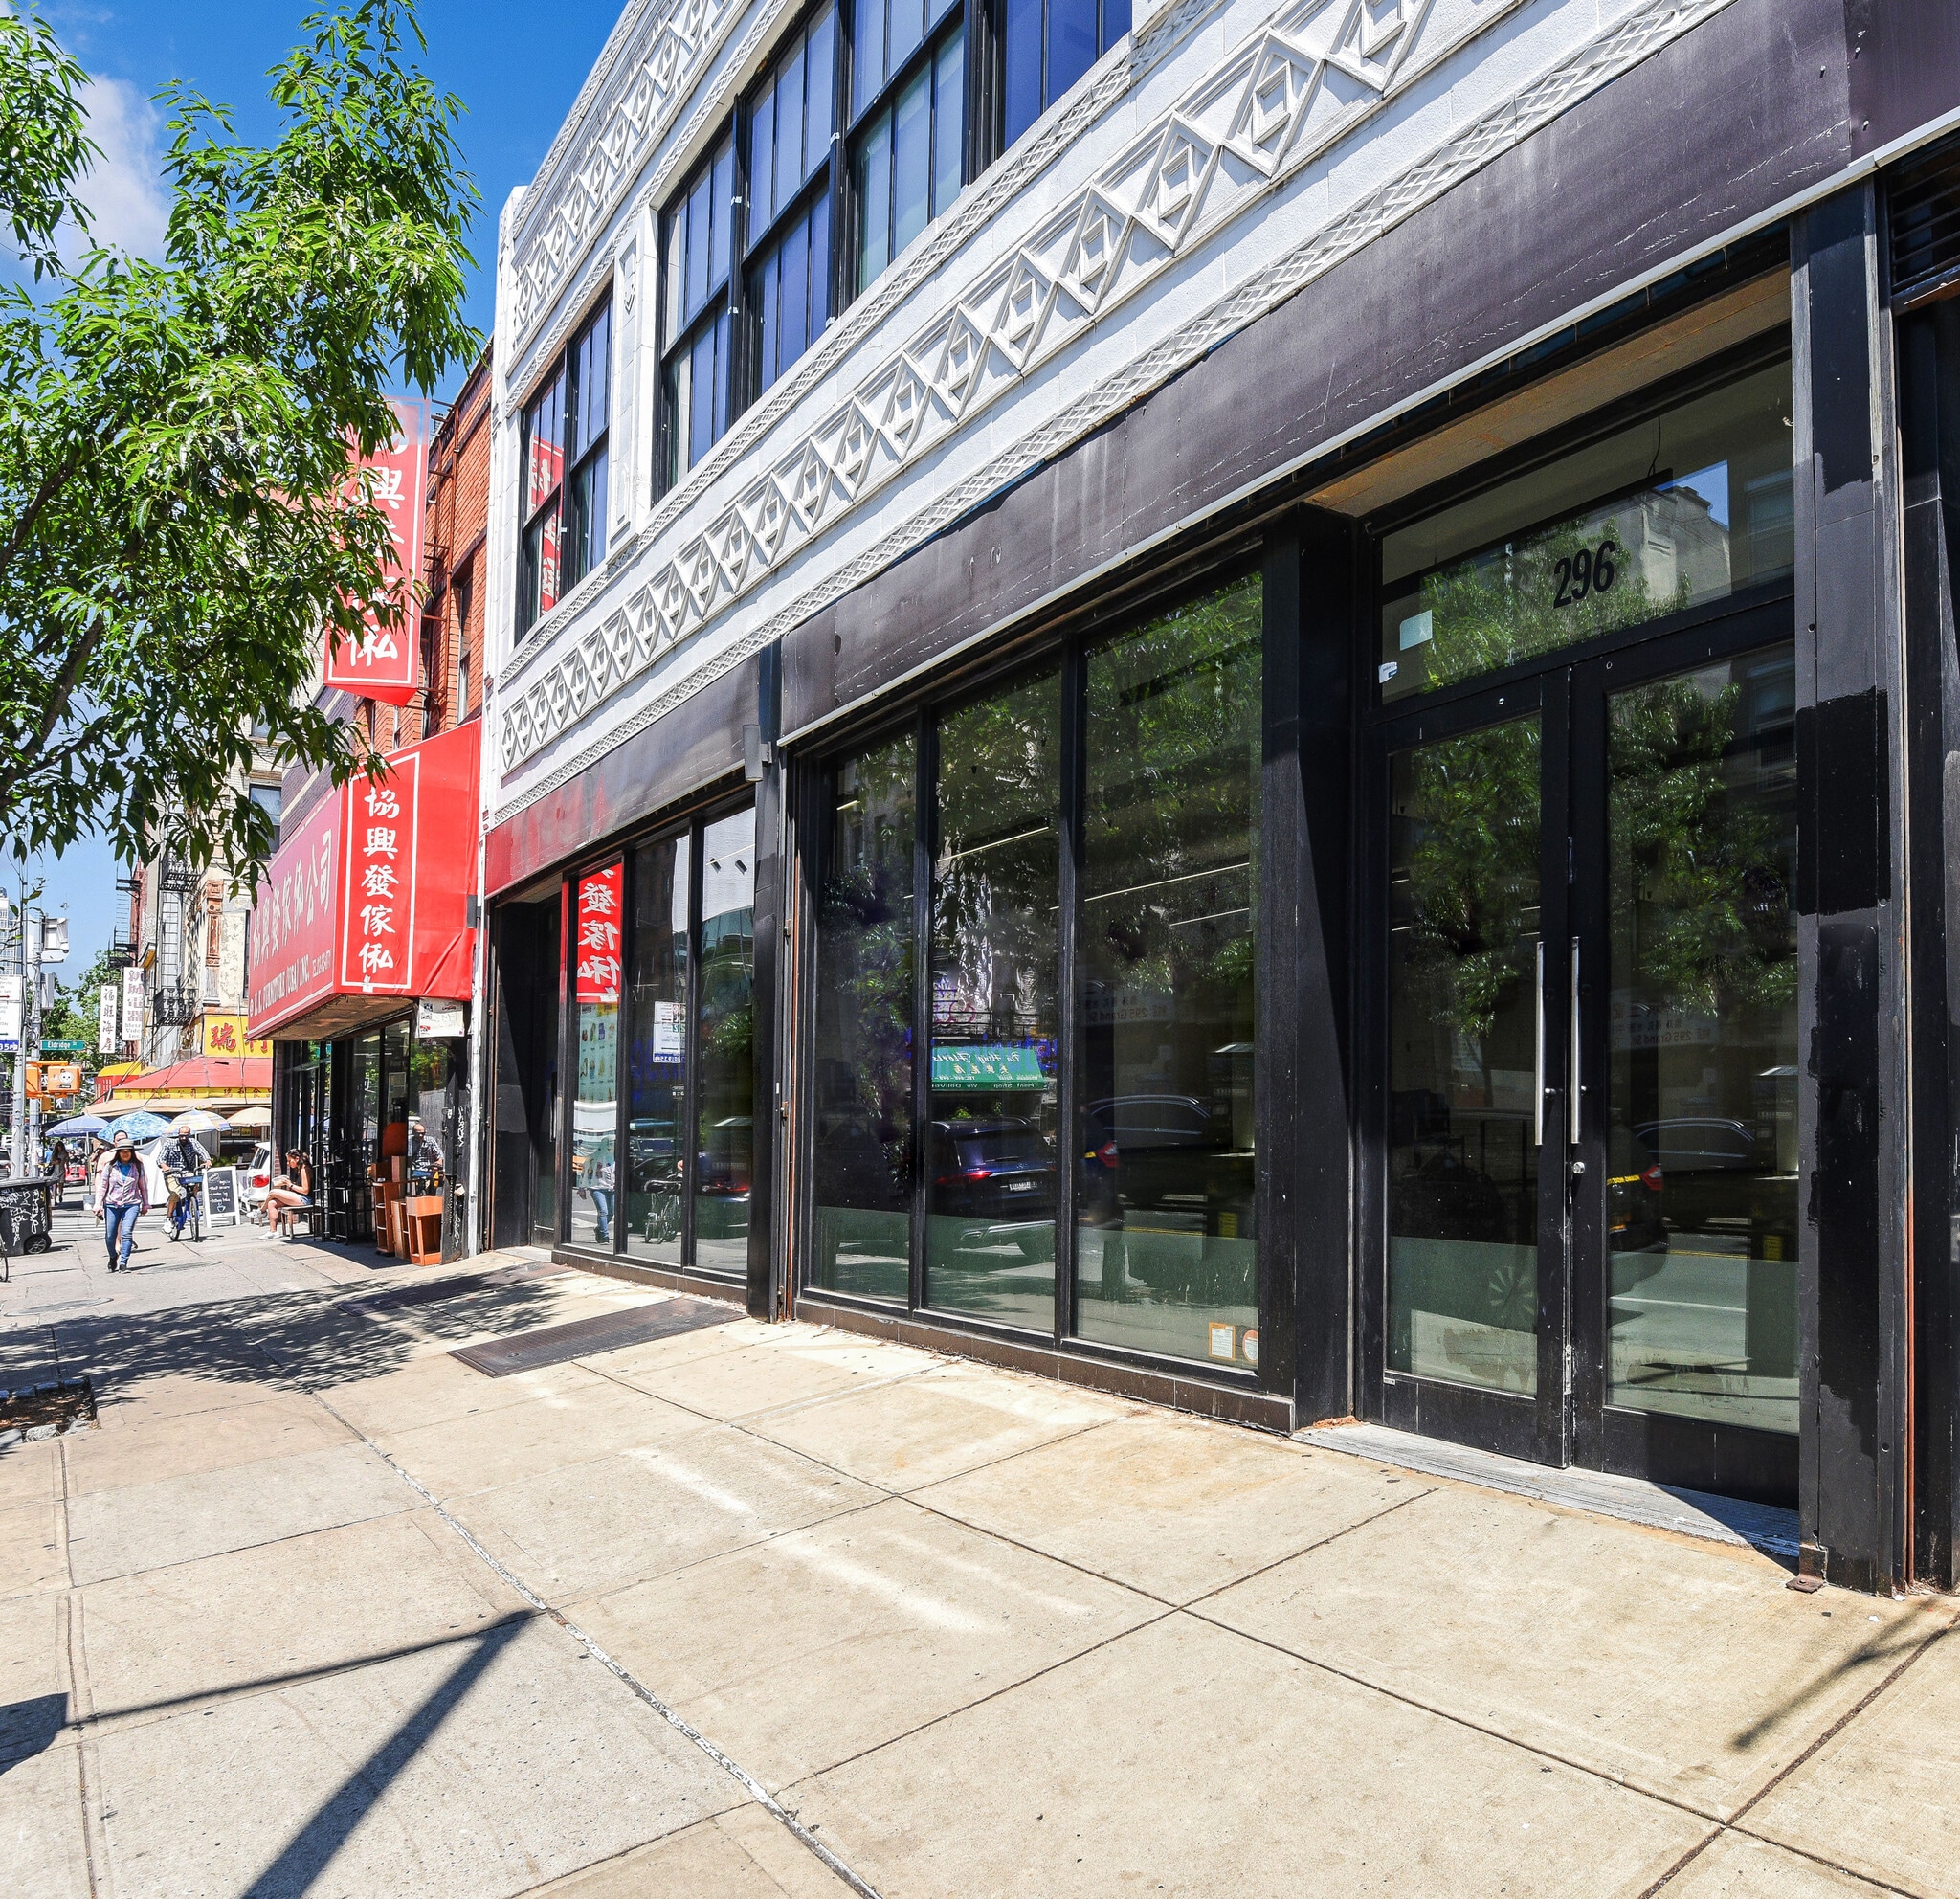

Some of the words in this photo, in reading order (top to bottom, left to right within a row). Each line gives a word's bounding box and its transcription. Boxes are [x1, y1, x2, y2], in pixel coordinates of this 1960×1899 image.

[1553, 540, 1616, 609] 296
[358, 786, 400, 974] 協興發傢俬
[47, 1041, 71, 1050] Eldridge
